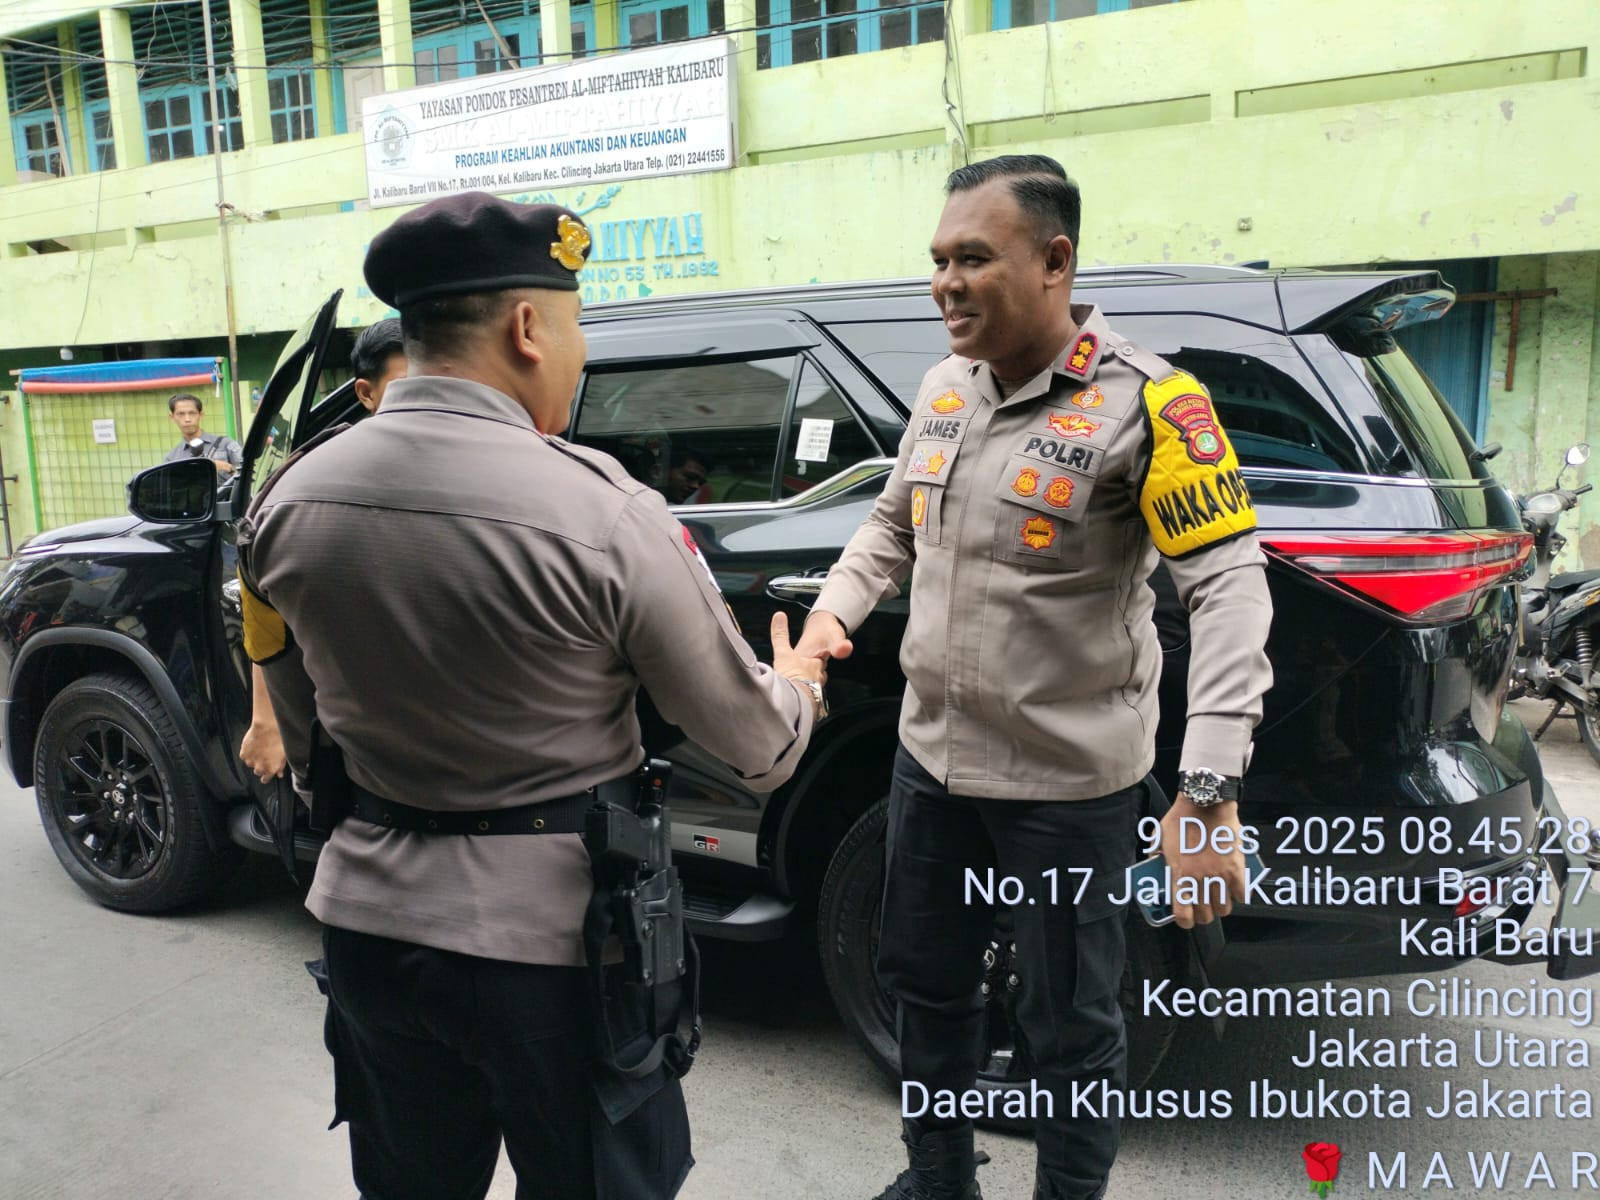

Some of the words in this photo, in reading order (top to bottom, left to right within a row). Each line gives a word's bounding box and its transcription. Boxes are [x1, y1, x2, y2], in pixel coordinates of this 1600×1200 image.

[420, 97, 463, 119] YAYASAN
[466, 89, 507, 113] PONDOK
[510, 81, 568, 108] PESANTREN
[571, 67, 663, 98] AL-MIFTAHIYYAH
[667, 58, 724, 84] KALIBARU
[455, 151, 499, 168] PROGRAM
[502, 144, 547, 164] KEAHLIAN
[550, 137, 604, 158] AKUNTANSI
[607, 134, 627, 151] DAN
[630, 127, 687, 148] KEUANGAN
[382, 186, 408, 198] Kalibaru
[409, 183, 427, 194] Barat
[498, 172, 512, 185] Kel.
[513, 171, 542, 184] Kalibaru
[543, 168, 560, 180] Kec.
[561, 164, 592, 179] Cilincing
[594, 162, 621, 175] Jakarta
[623, 159, 644, 171] Utara
[646, 156, 664, 170] Telp.
[666, 153, 686, 170] (021)
[687, 149, 725, 164] 22441556
[919, 419, 961, 440] JAMES
[1023, 437, 1094, 471] POLRI
[1152, 480, 1225, 540] WAKA
